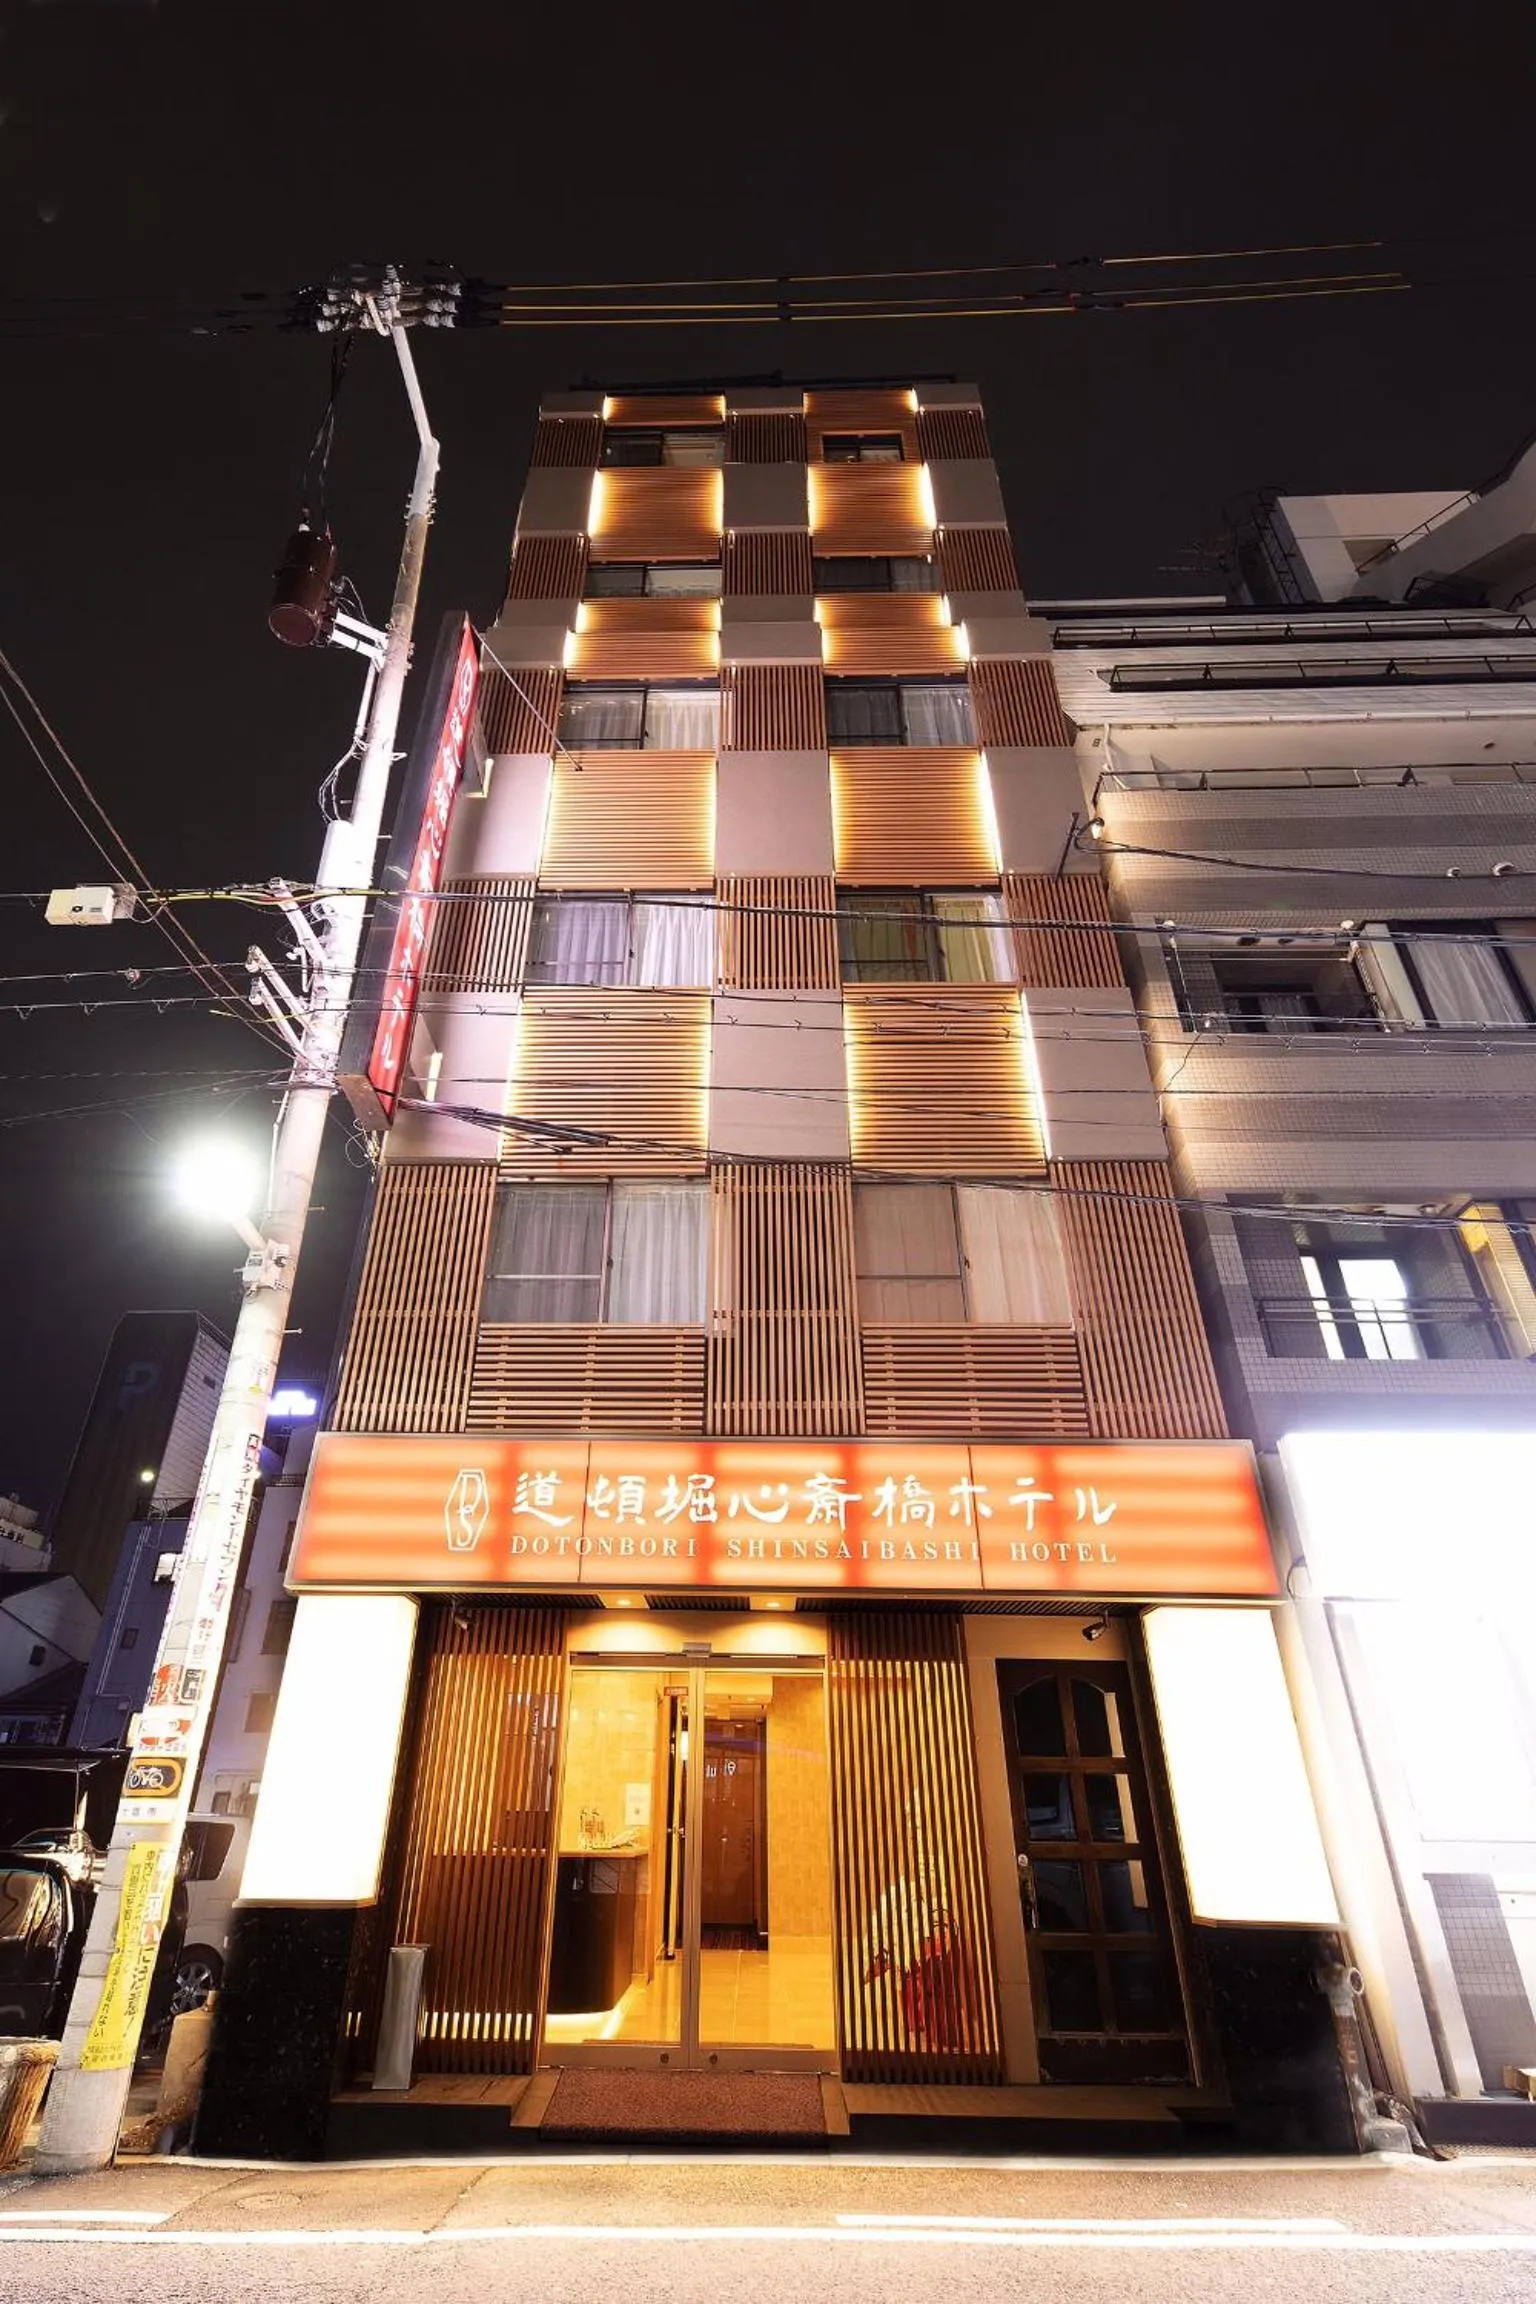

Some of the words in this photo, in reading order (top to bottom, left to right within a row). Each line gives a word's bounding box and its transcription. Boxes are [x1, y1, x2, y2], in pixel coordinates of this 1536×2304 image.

[511, 1470, 1118, 1532] 道頓堀心斎橋ホテル
[511, 1535, 697, 1558] DOTONBORI
[727, 1539, 981, 1561] SHINSAIBASHI
[1010, 1541, 1117, 1563] HOTEL
